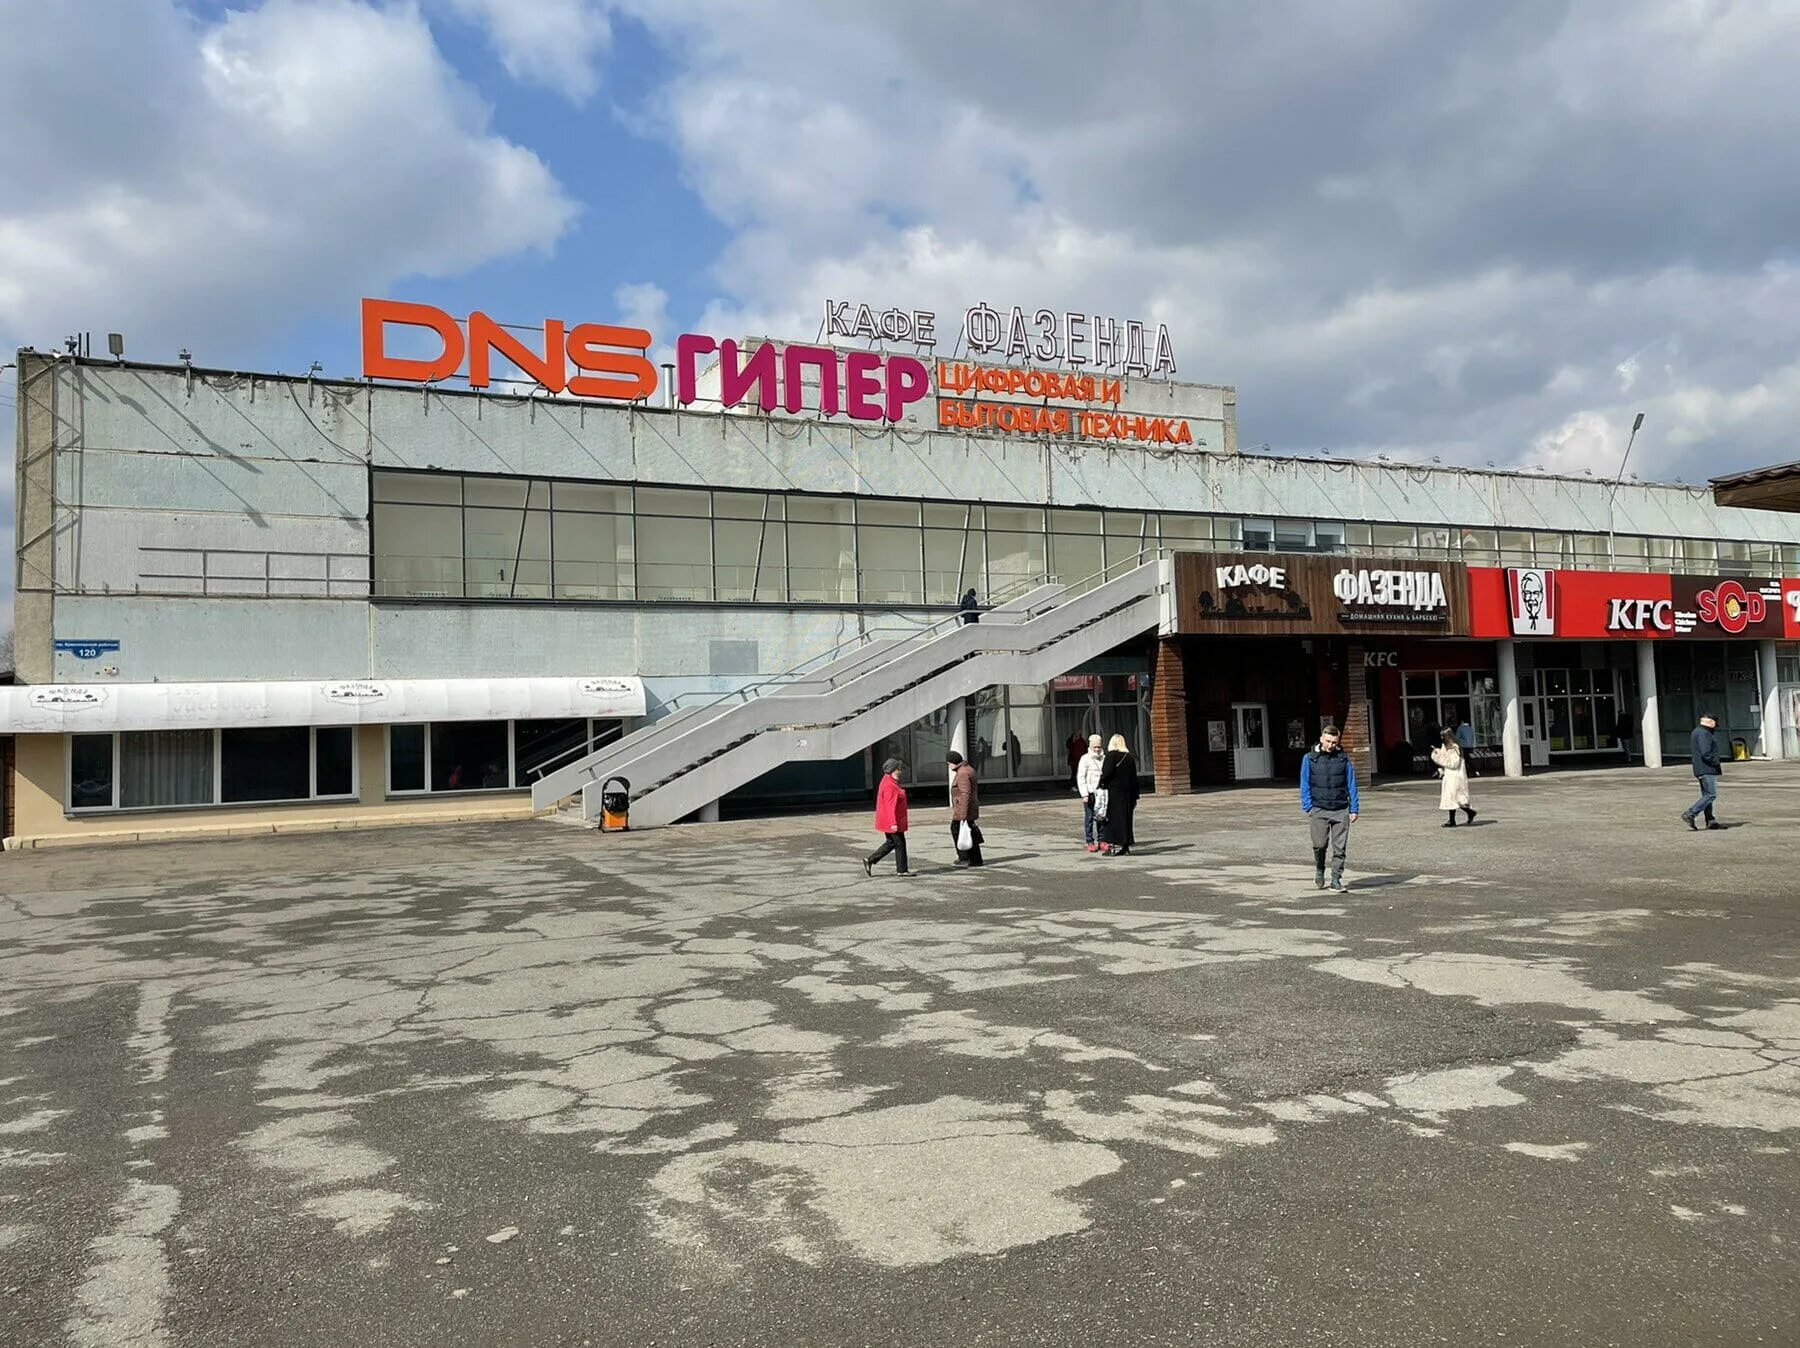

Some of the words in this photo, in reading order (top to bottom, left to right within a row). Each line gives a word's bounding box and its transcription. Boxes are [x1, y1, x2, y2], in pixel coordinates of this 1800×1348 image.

[362, 298, 659, 400] DNS
[824, 299, 937, 346] КАФЕ
[964, 302, 1176, 378] ФАЗЕНДА
[676, 333, 929, 423] ГИПЕР
[938, 362, 1095, 402] ЦИФРОВАЯ
[1101, 379, 1121, 404] И
[939, 400, 1070, 433] БЫТОВАЯ
[1077, 411, 1193, 445] ТЕХНИКА
[1216, 564, 1286, 589] КАФЕ
[1333, 569, 1447, 611] ФАЗЕНДА
[1608, 598, 1672, 630] KFC
[1697, 580, 1766, 634] SCD
[79, 649, 96, 657] 120
[1363, 651, 1398, 667] KFC
